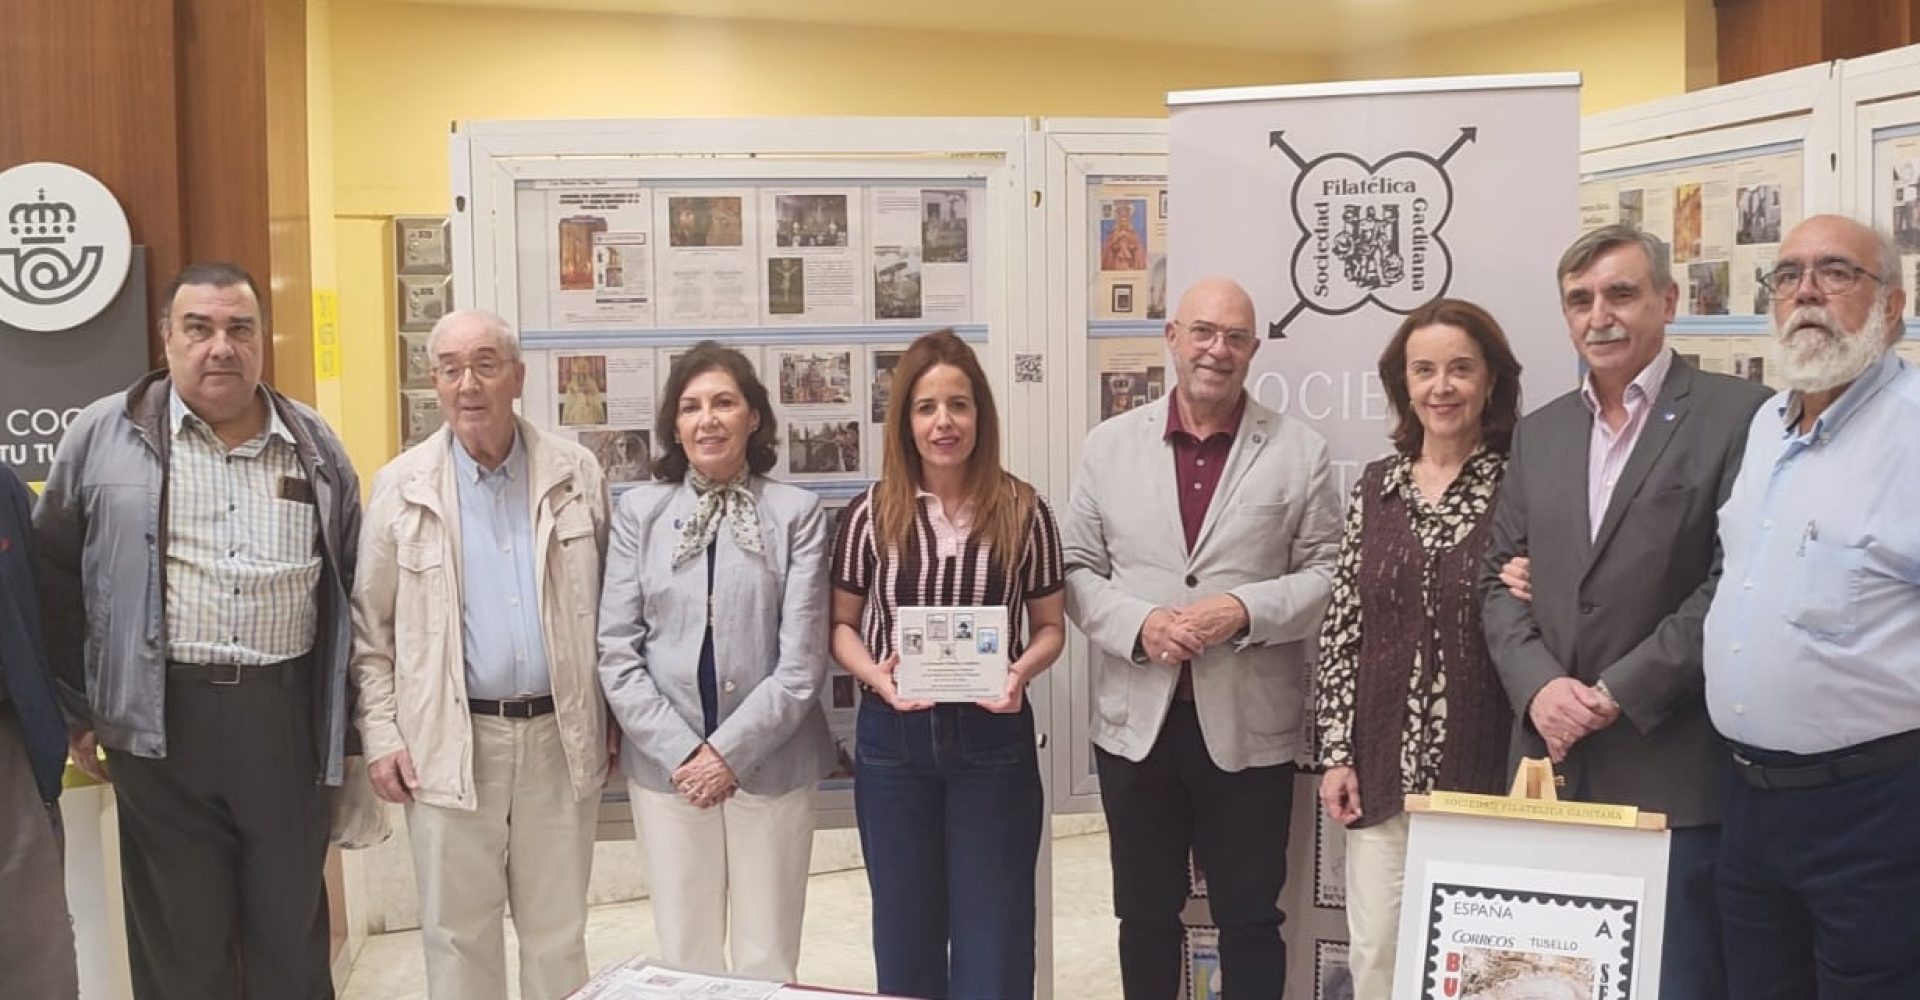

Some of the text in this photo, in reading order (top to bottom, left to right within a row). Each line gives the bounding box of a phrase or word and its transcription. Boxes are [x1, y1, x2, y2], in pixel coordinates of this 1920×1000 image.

[1322, 177, 1416, 196] Filatélica
[1313, 202, 1330, 297] Sociedad
[1412, 197, 1429, 291] Gaditana
[0, 444, 26, 465] TU
[1454, 901, 1514, 919] ESPAÑA
[1595, 919, 1613, 940] A
